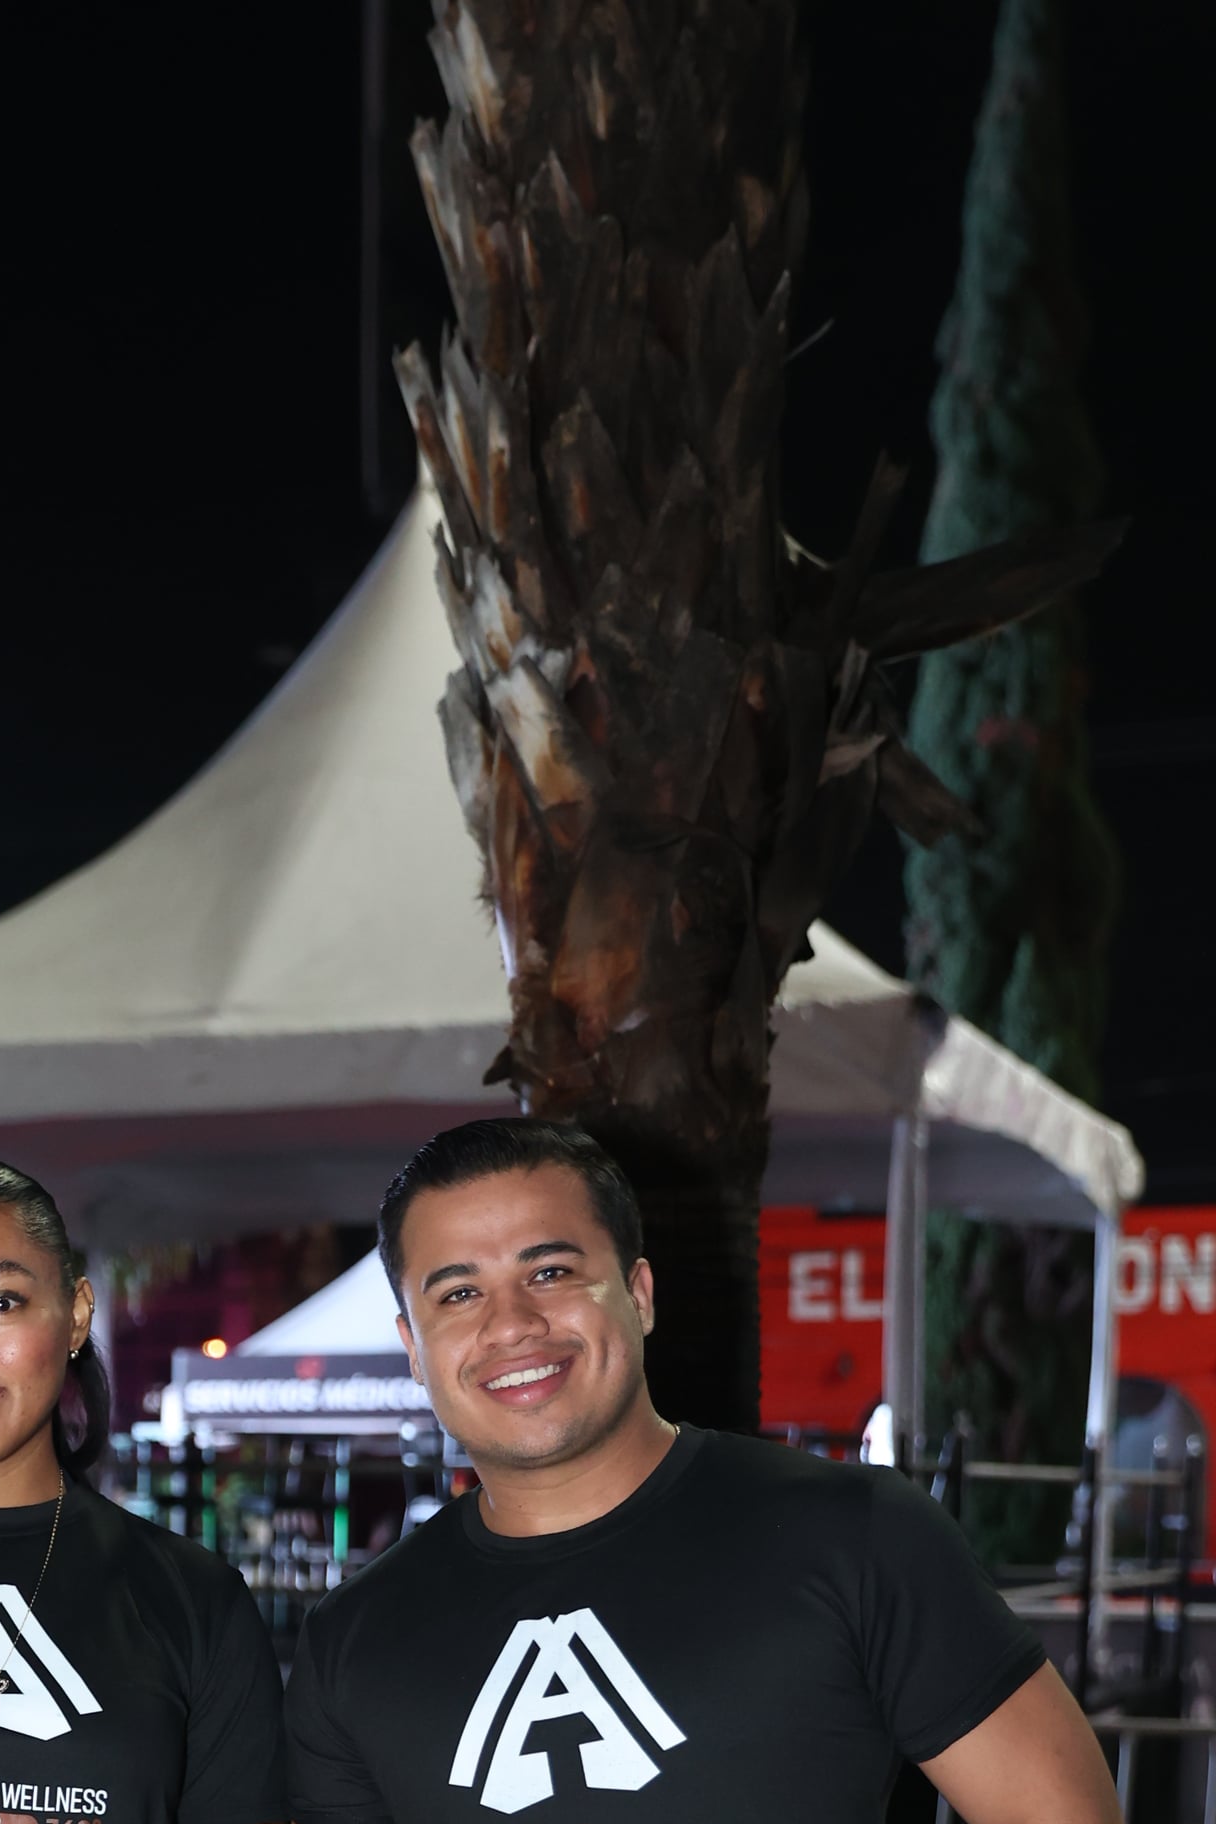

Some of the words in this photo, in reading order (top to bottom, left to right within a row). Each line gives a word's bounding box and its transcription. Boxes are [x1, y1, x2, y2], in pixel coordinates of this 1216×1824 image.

[788, 1249, 884, 1322] EL
[320, 1374, 435, 1412] MÉDICO
[1, 1782, 108, 1815] WELLNESS
